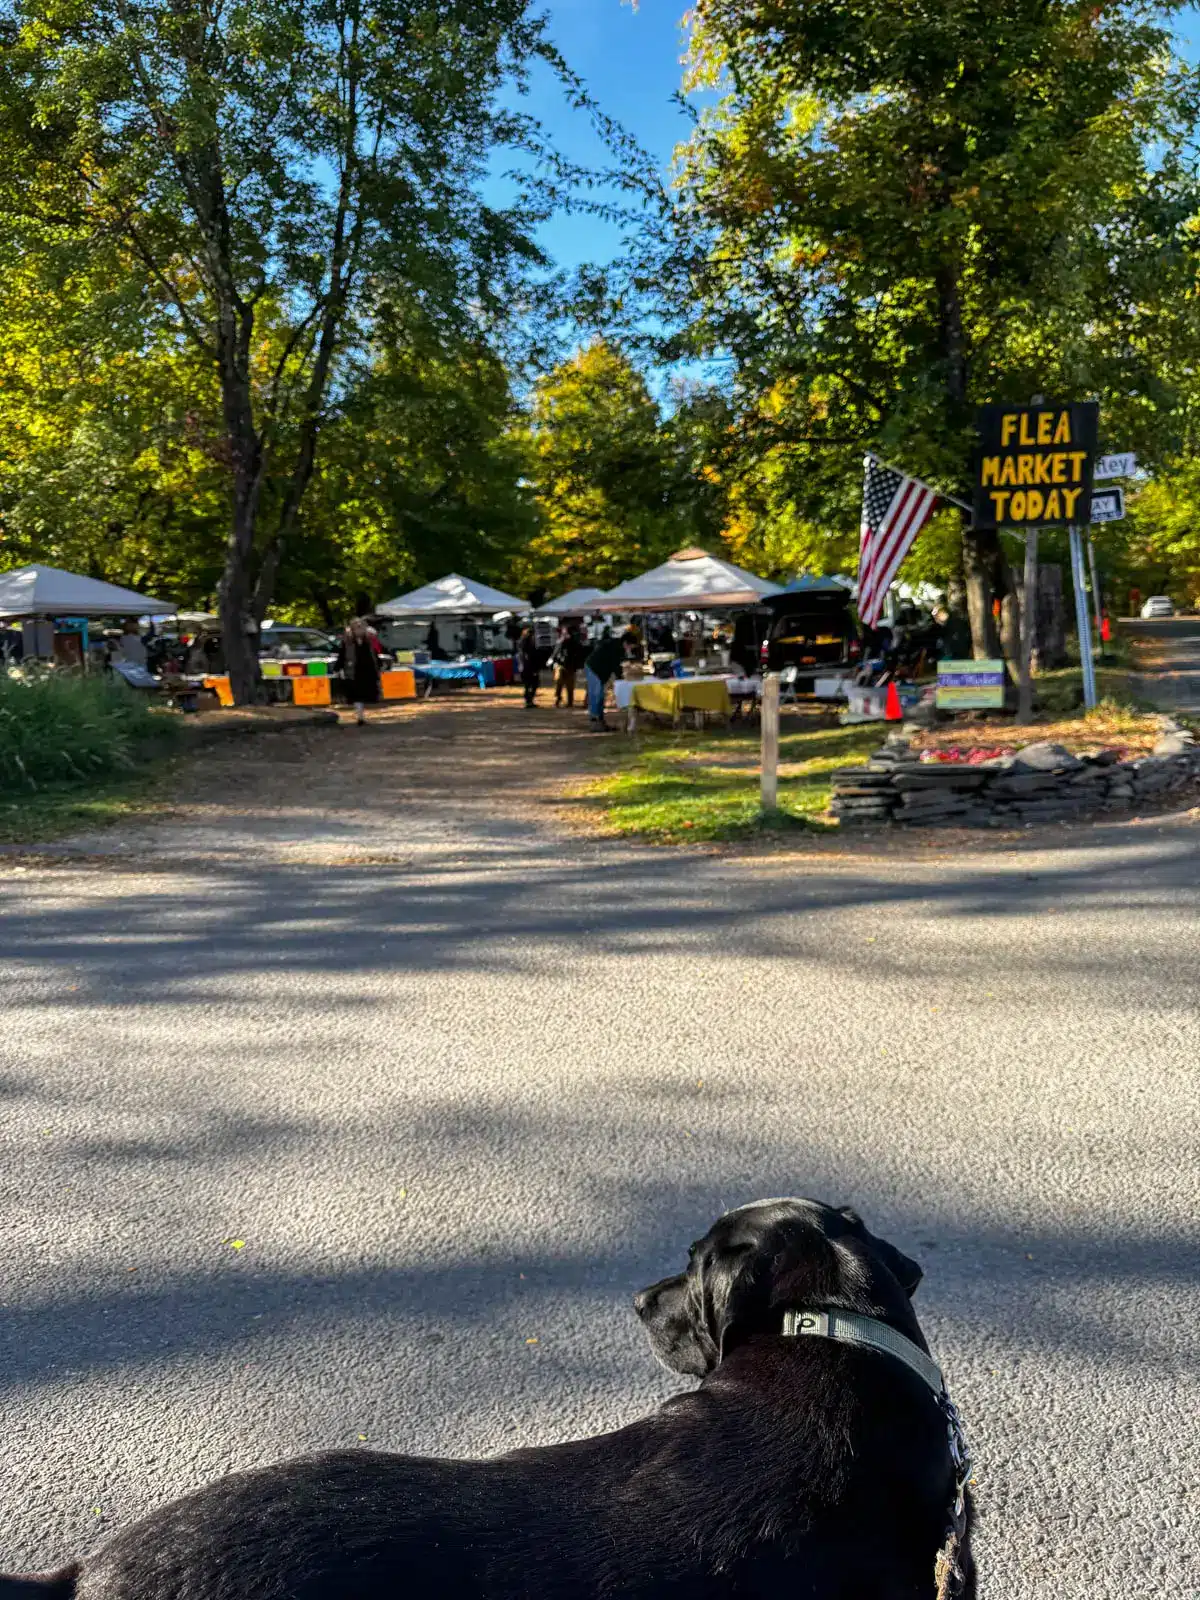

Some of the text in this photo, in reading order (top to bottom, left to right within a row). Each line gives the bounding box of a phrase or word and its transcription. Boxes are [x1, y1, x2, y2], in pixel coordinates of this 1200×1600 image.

[1001, 410, 1072, 448] FLEA
[981, 451, 1087, 488] MARKET
[989, 487, 1084, 522] TODAY
